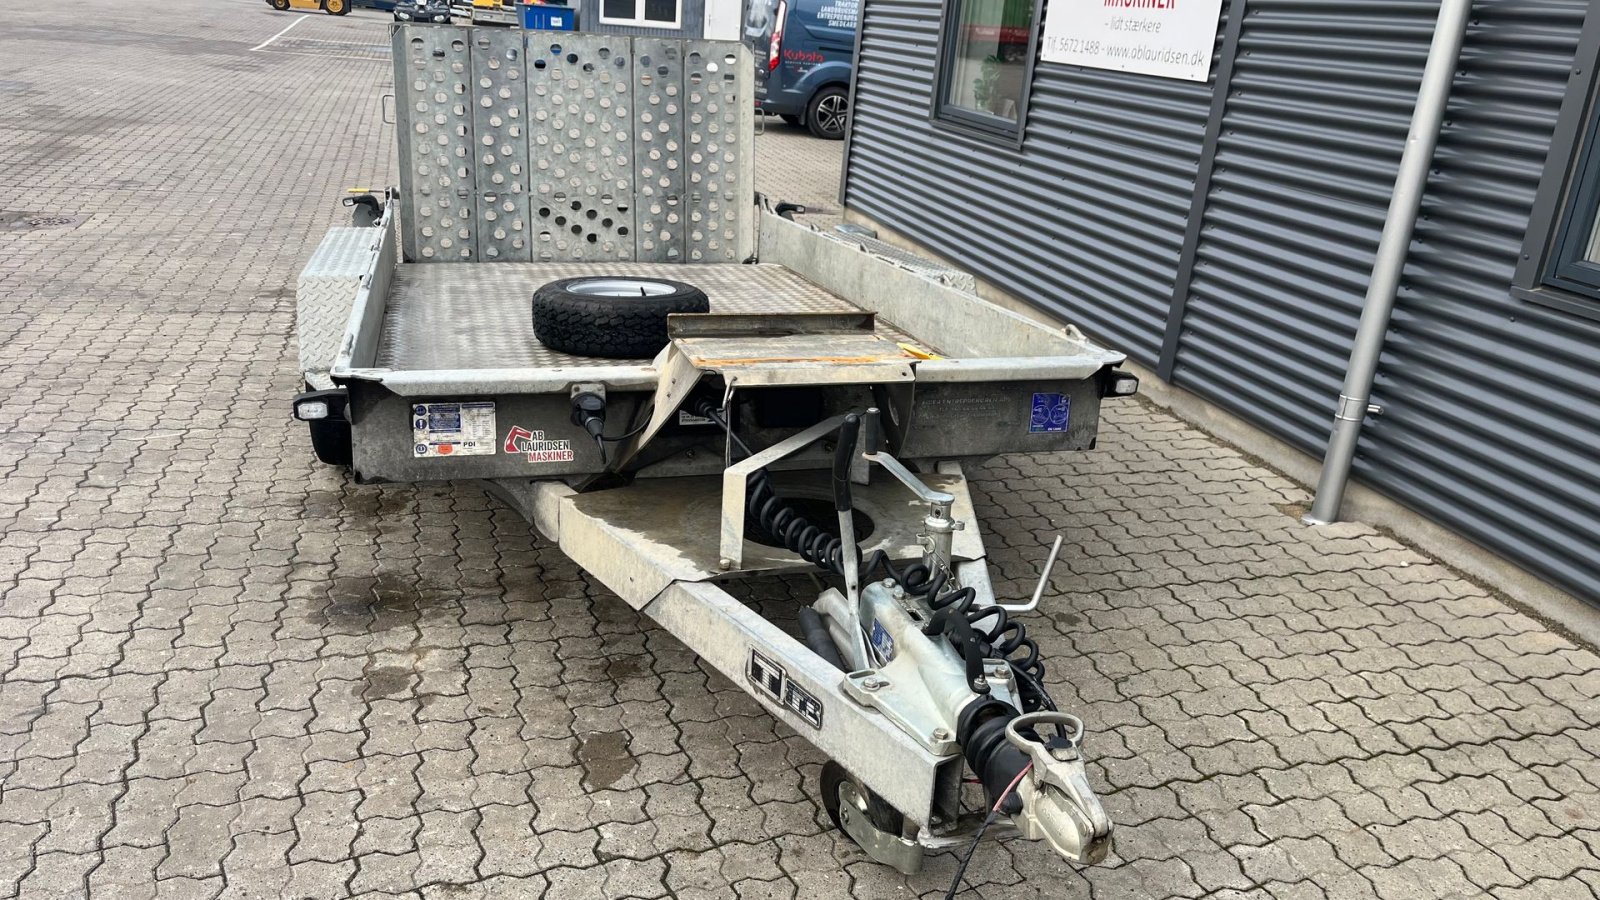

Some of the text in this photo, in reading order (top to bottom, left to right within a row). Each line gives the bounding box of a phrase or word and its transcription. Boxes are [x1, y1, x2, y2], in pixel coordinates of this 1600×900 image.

[1124, 16, 1162, 33] stærkere
[784, 48, 825, 62] Kubota
[1059, 37, 1078, 53] 5672
[1080, 39, 1101, 55] 1488
[1107, 44, 1205, 67] www.ablauridsen.dk
[532, 431, 544, 441] AB
[521, 440, 570, 452] LAURIDSEN
[528, 451, 573, 462] MASKINER
